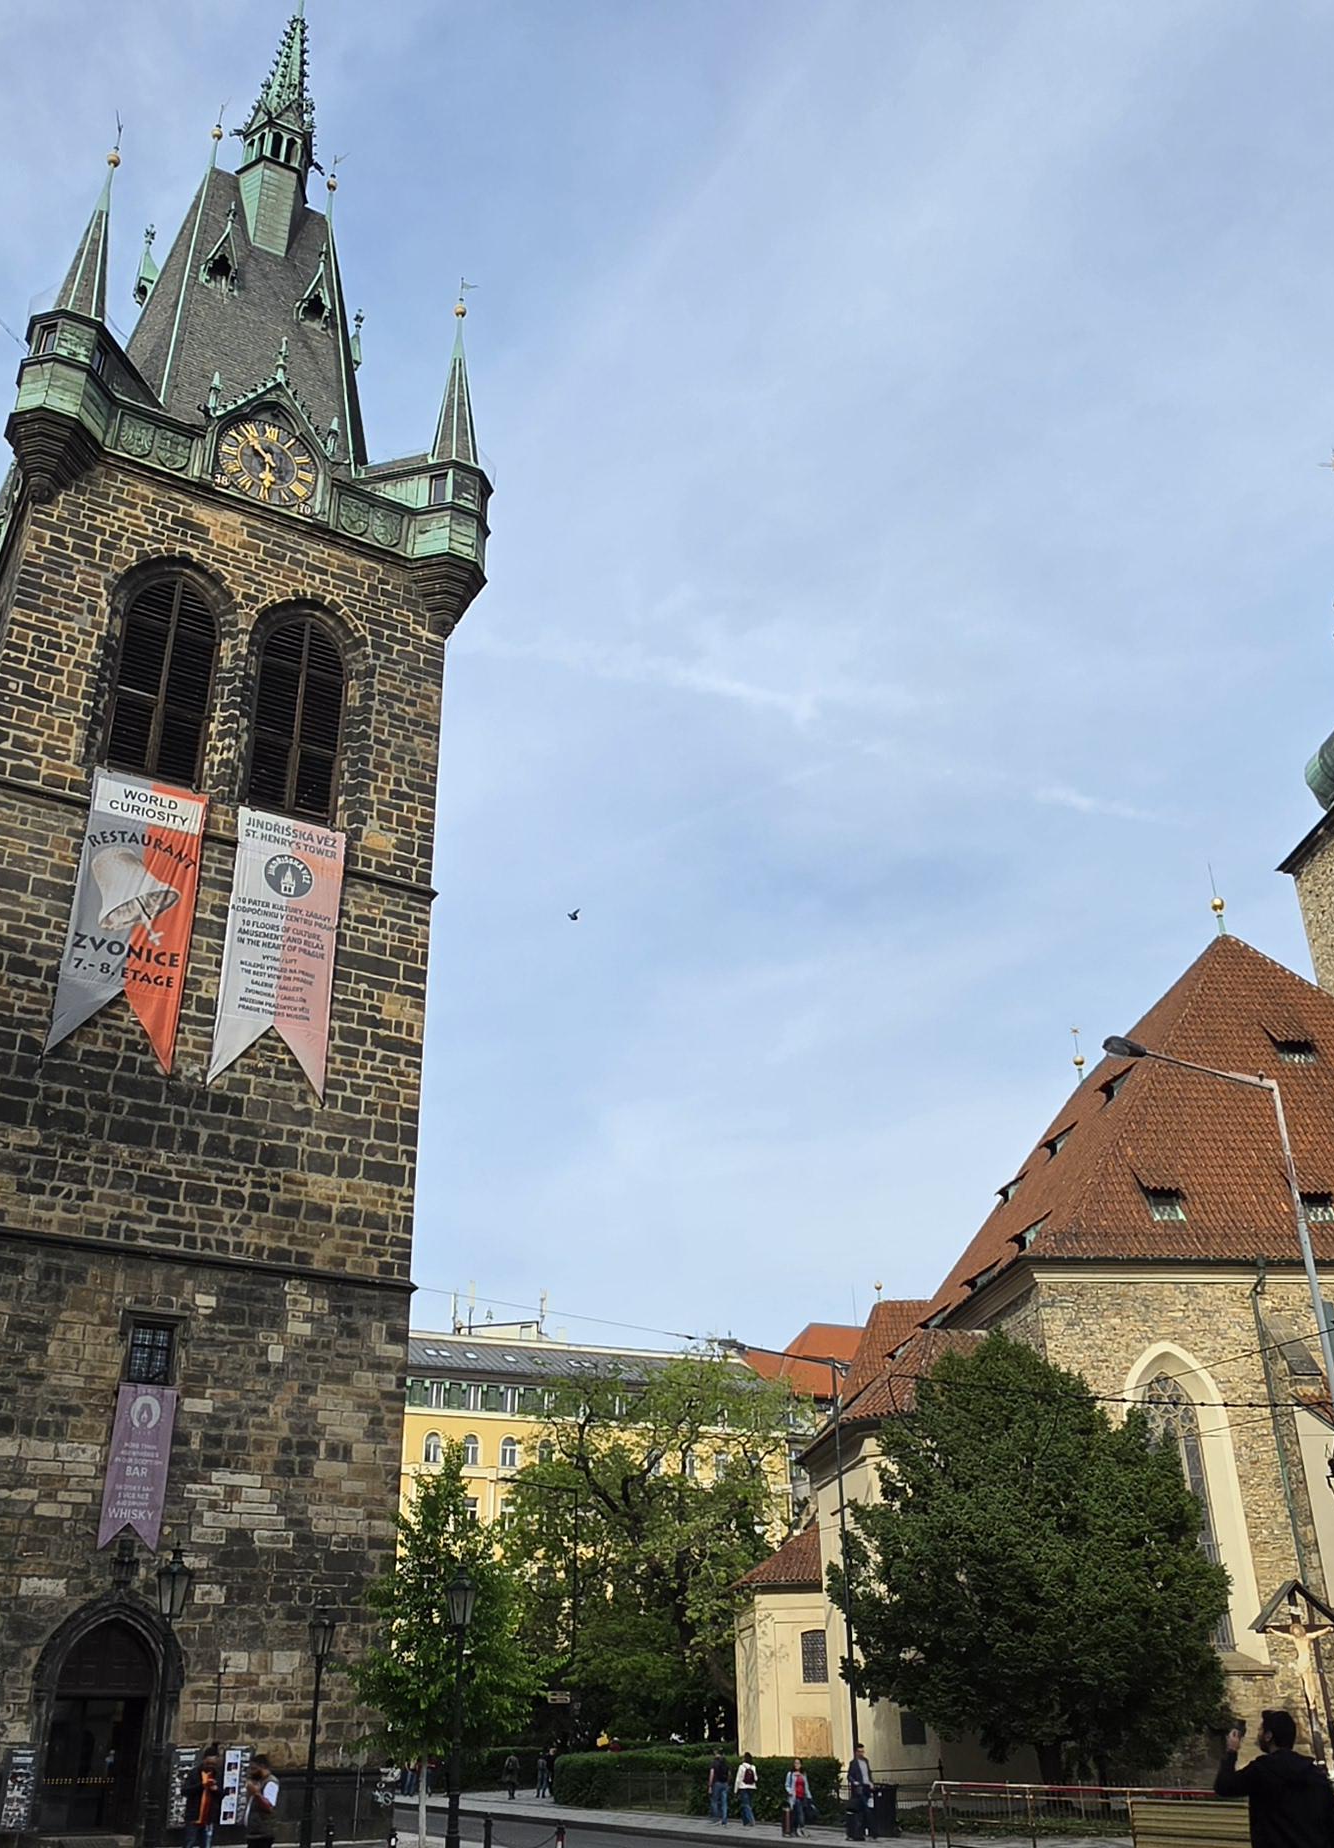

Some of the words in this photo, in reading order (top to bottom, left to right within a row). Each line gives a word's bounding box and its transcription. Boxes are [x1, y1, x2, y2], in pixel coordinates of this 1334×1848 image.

[124, 788, 178, 810] WORLD
[109, 800, 188, 826] CURIOSITY
[246, 817, 314, 842] JINDŘIŠSKÁ
[316, 834, 337, 848] VĚŽ
[87, 830, 196, 870] RESTAURANT
[245, 829, 258, 839] ST.
[261, 832, 301, 850] HENRY'S
[303, 844, 337, 859] TOWER
[248, 898, 270, 908] PATER
[252, 921, 280, 932] FLOORS
[72, 932, 180, 968] ZVONICE
[247, 938, 260, 947] THE
[287, 936, 302, 945] AND
[99, 962, 115, 976] 8.
[121, 967, 174, 988] ETAGE
[125, 1466, 148, 1477] BAR
[108, 1507, 154, 1520] WHISKY
